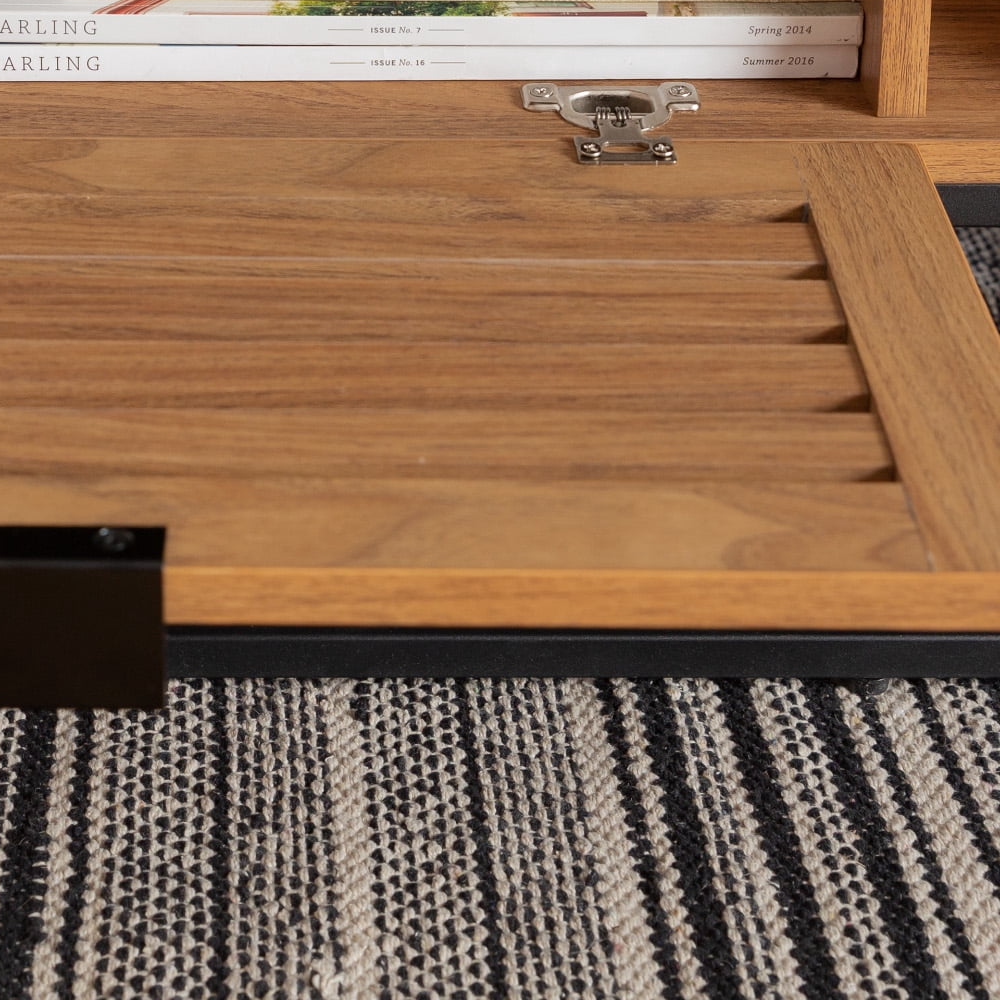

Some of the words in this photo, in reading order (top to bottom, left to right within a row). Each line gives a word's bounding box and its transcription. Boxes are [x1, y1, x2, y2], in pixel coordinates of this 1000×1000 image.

[398, 26, 413, 34] No.
[748, 25, 783, 37] Spring
[785, 25, 812, 35] 2014
[370, 59, 396, 67] ISSUE
[398, 58, 413, 67] No.
[415, 59, 425, 67] 16
[742, 56, 785, 66] Summer
[787, 56, 815, 66] 2016
